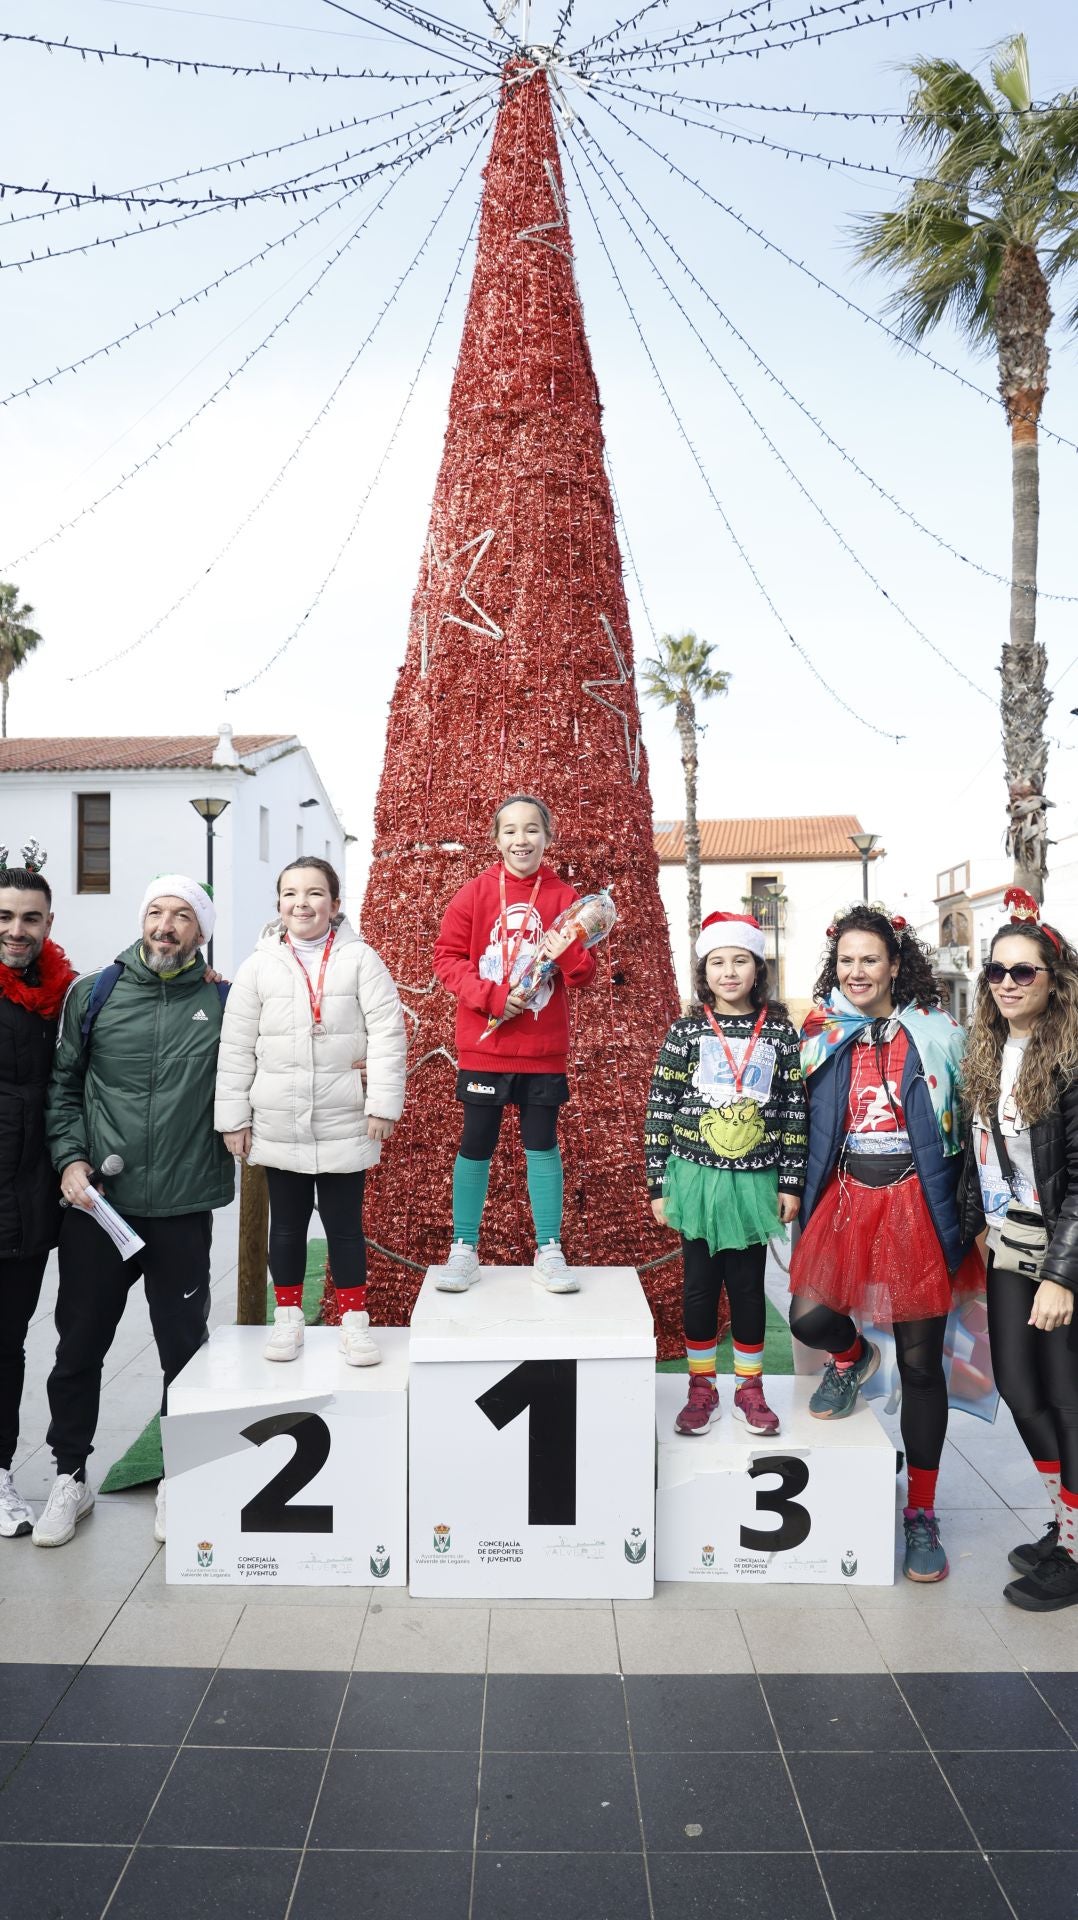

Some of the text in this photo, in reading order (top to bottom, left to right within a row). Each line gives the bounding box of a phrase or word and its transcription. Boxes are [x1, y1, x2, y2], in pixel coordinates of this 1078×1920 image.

[714, 1061, 762, 1087] 20
[239, 1411, 333, 1534] 2
[475, 1359, 577, 1526] 1
[739, 1455, 812, 1552] 3
